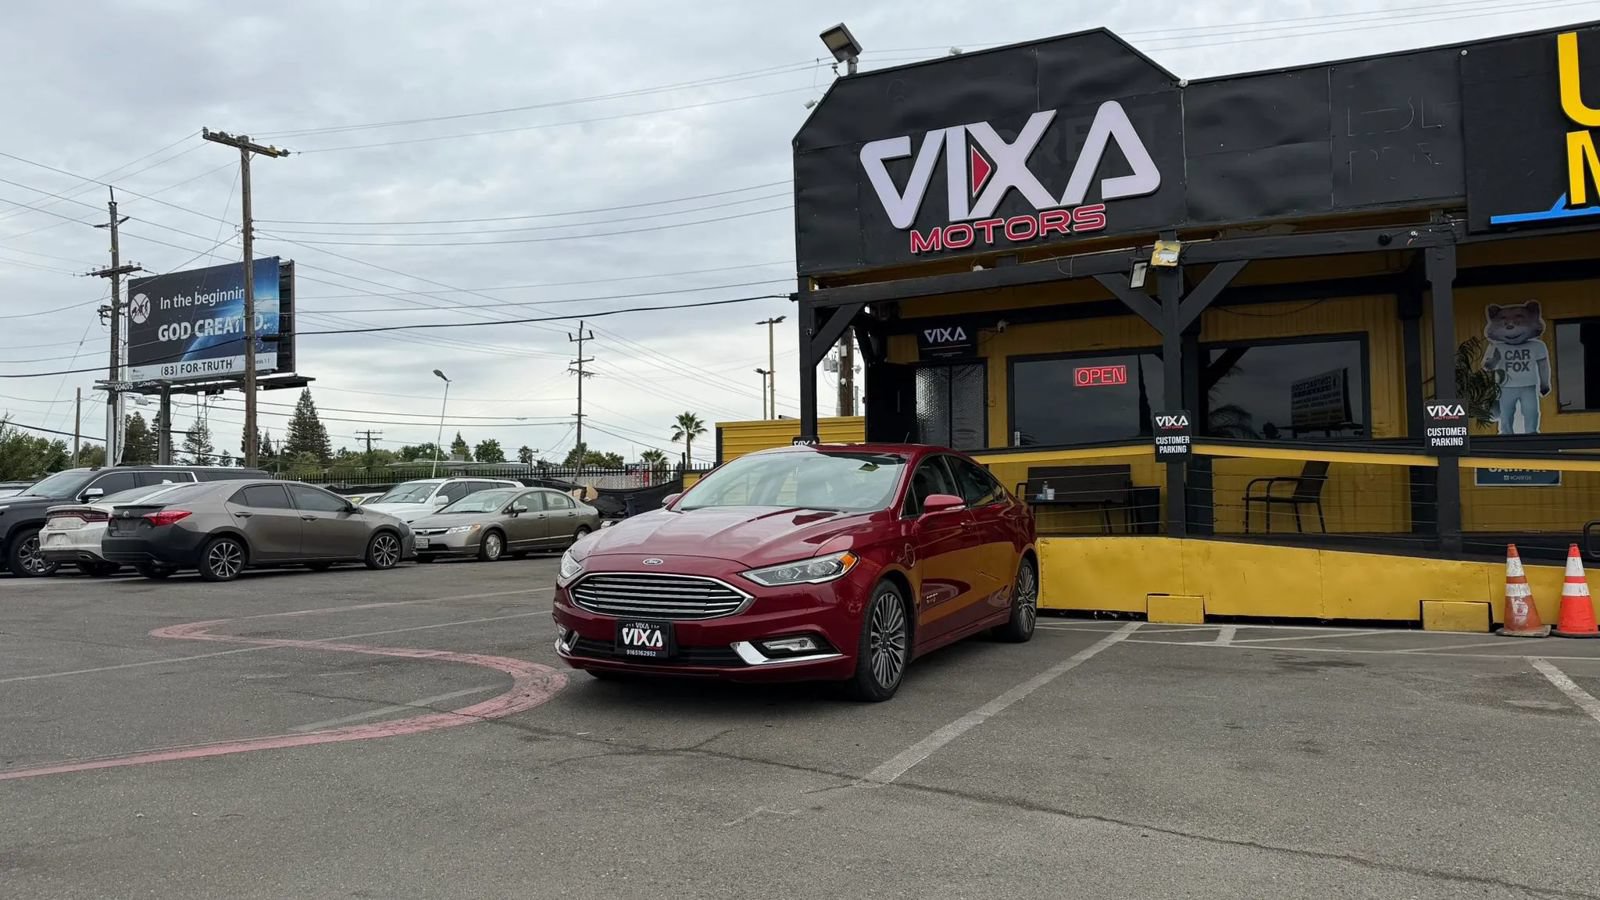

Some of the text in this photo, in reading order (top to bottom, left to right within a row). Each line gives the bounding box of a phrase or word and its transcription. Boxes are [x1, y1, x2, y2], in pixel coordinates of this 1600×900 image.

[860, 100, 1160, 230] VIXA
[910, 204, 1106, 253] MOTORS
[160, 286, 245, 310] In the beginnin
[158, 321, 192, 342] GOD
[923, 326, 967, 343] VIXA
[1504, 349, 1531, 361] CAR
[160, 365, 178, 377] (83)
[180, 359, 233, 374] FOR-TRUTH
[1505, 361, 1530, 372] FOX
[1078, 367, 1124, 384] OPEN
[1426, 404, 1466, 417] VIXA
[1155, 415, 1189, 427] VIXA
[1427, 427, 1467, 437] CUSTOMER
[1155, 436, 1190, 445] CUSTOMER
[1431, 437, 1464, 447] PARKING
[1159, 445, 1187, 454] PARKING
[622, 627, 663, 648] VIXA
